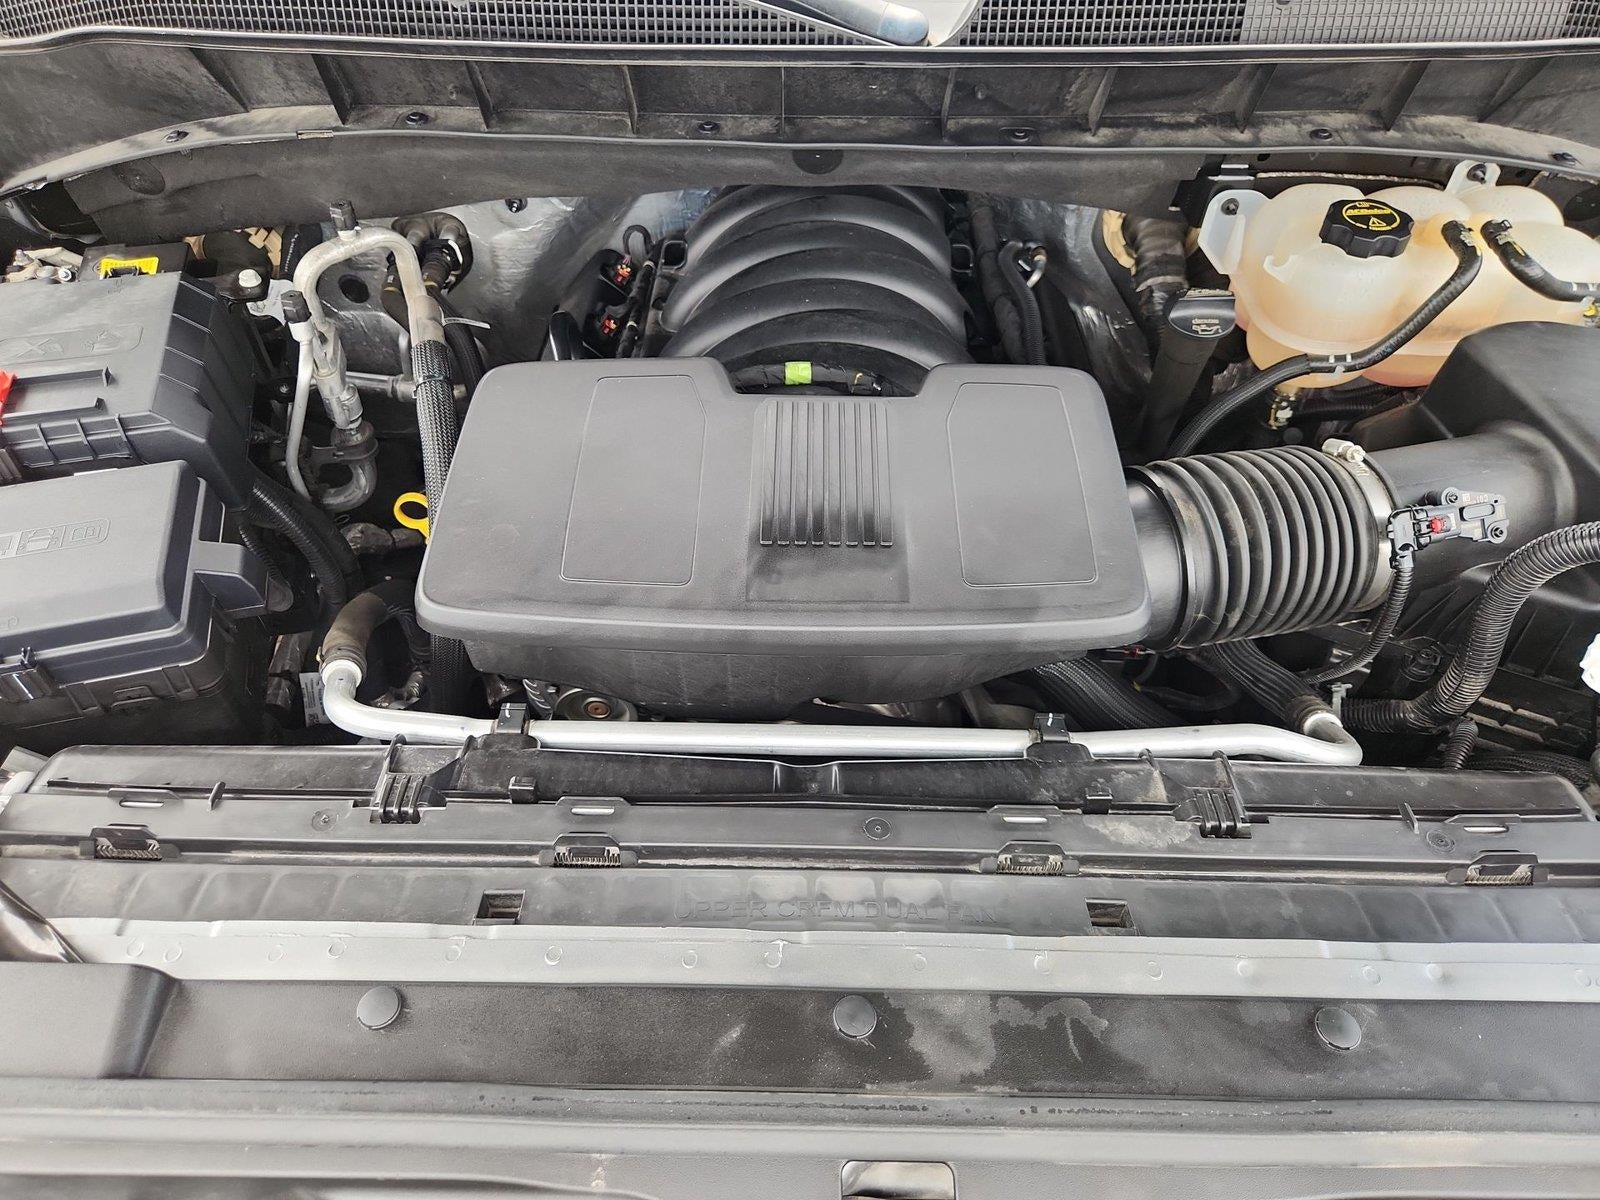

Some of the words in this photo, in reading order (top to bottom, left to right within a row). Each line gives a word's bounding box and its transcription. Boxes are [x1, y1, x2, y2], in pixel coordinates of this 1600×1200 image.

[673, 901, 767, 920] UPPER
[865, 901, 938, 921] DUAL
[947, 902, 998, 924] FAN
